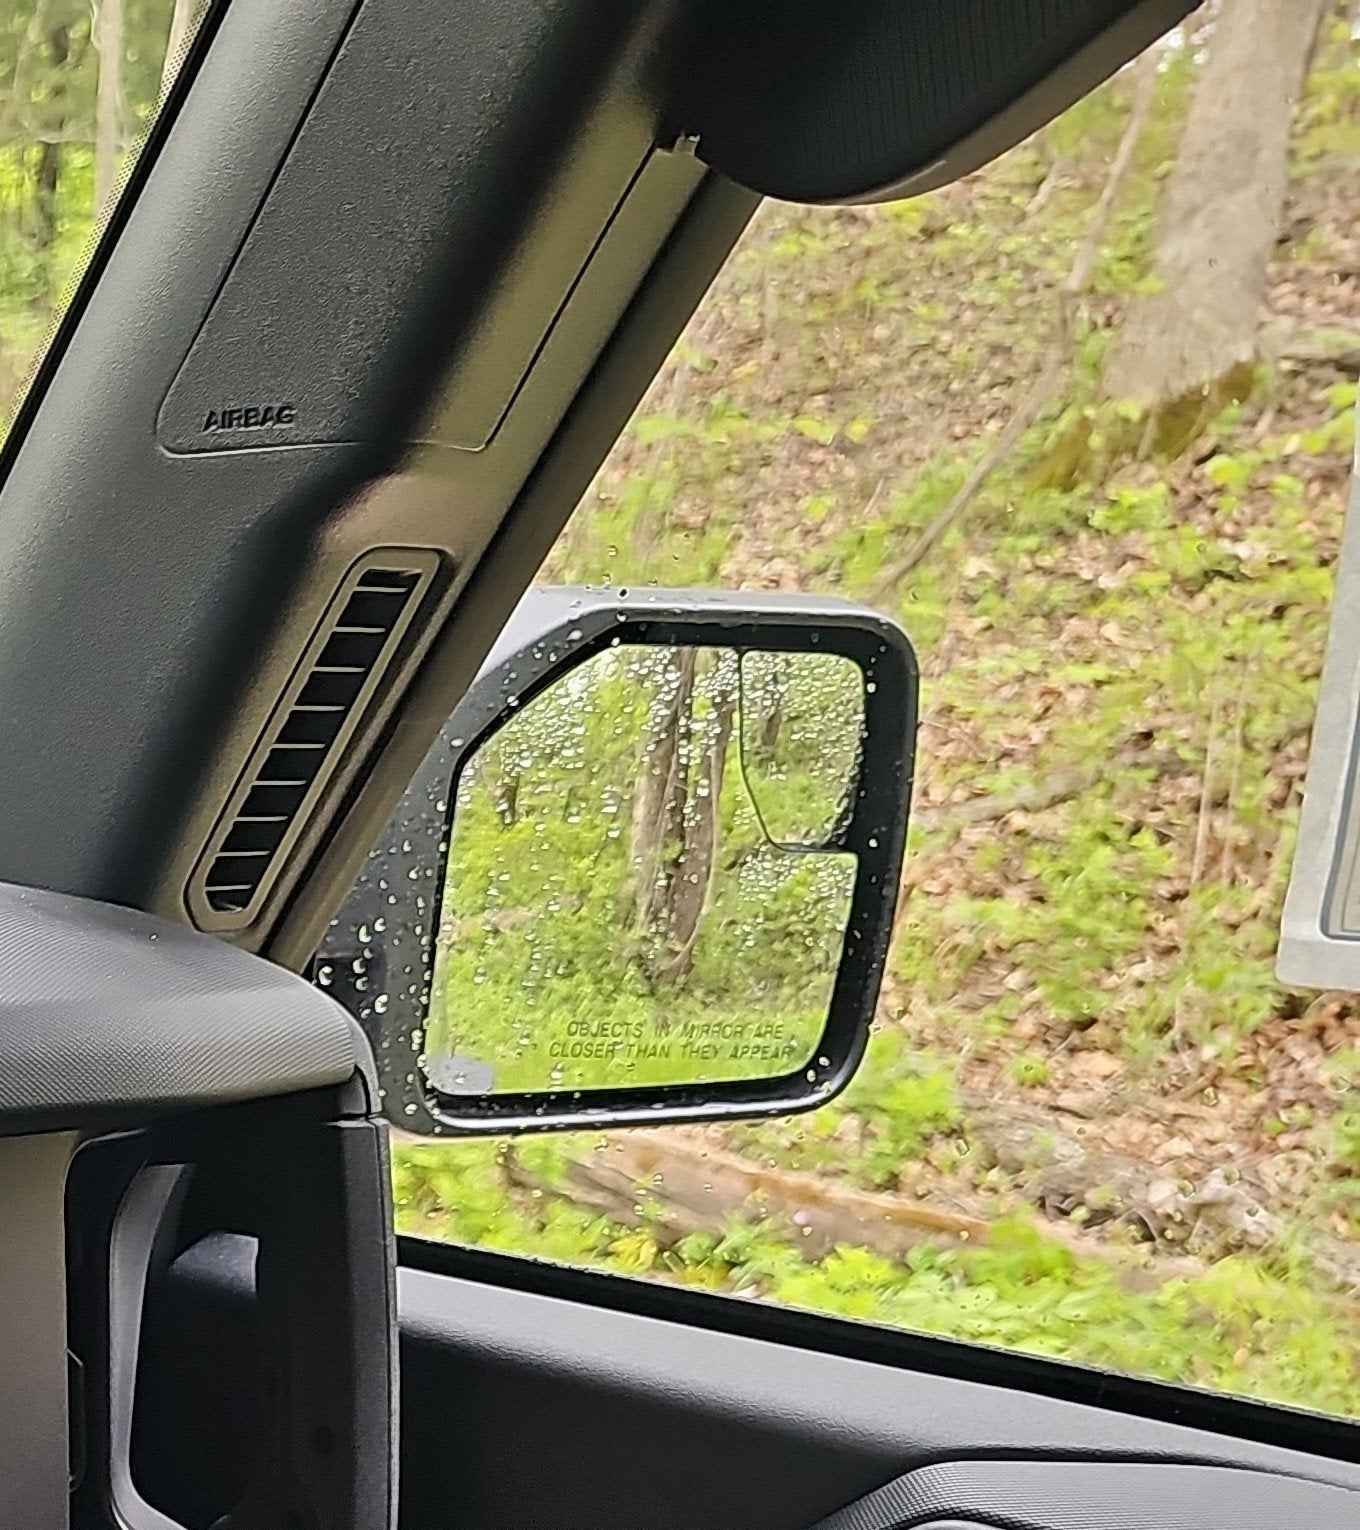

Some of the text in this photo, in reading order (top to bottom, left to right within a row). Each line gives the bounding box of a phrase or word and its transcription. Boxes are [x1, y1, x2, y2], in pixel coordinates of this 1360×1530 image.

[202, 405, 298, 432] AIRBAG
[566, 1017, 785, 1040] OBJECTS IN MIRROR ARE
[549, 1041, 795, 1060] CLOSER THAN THEY APPEAR
